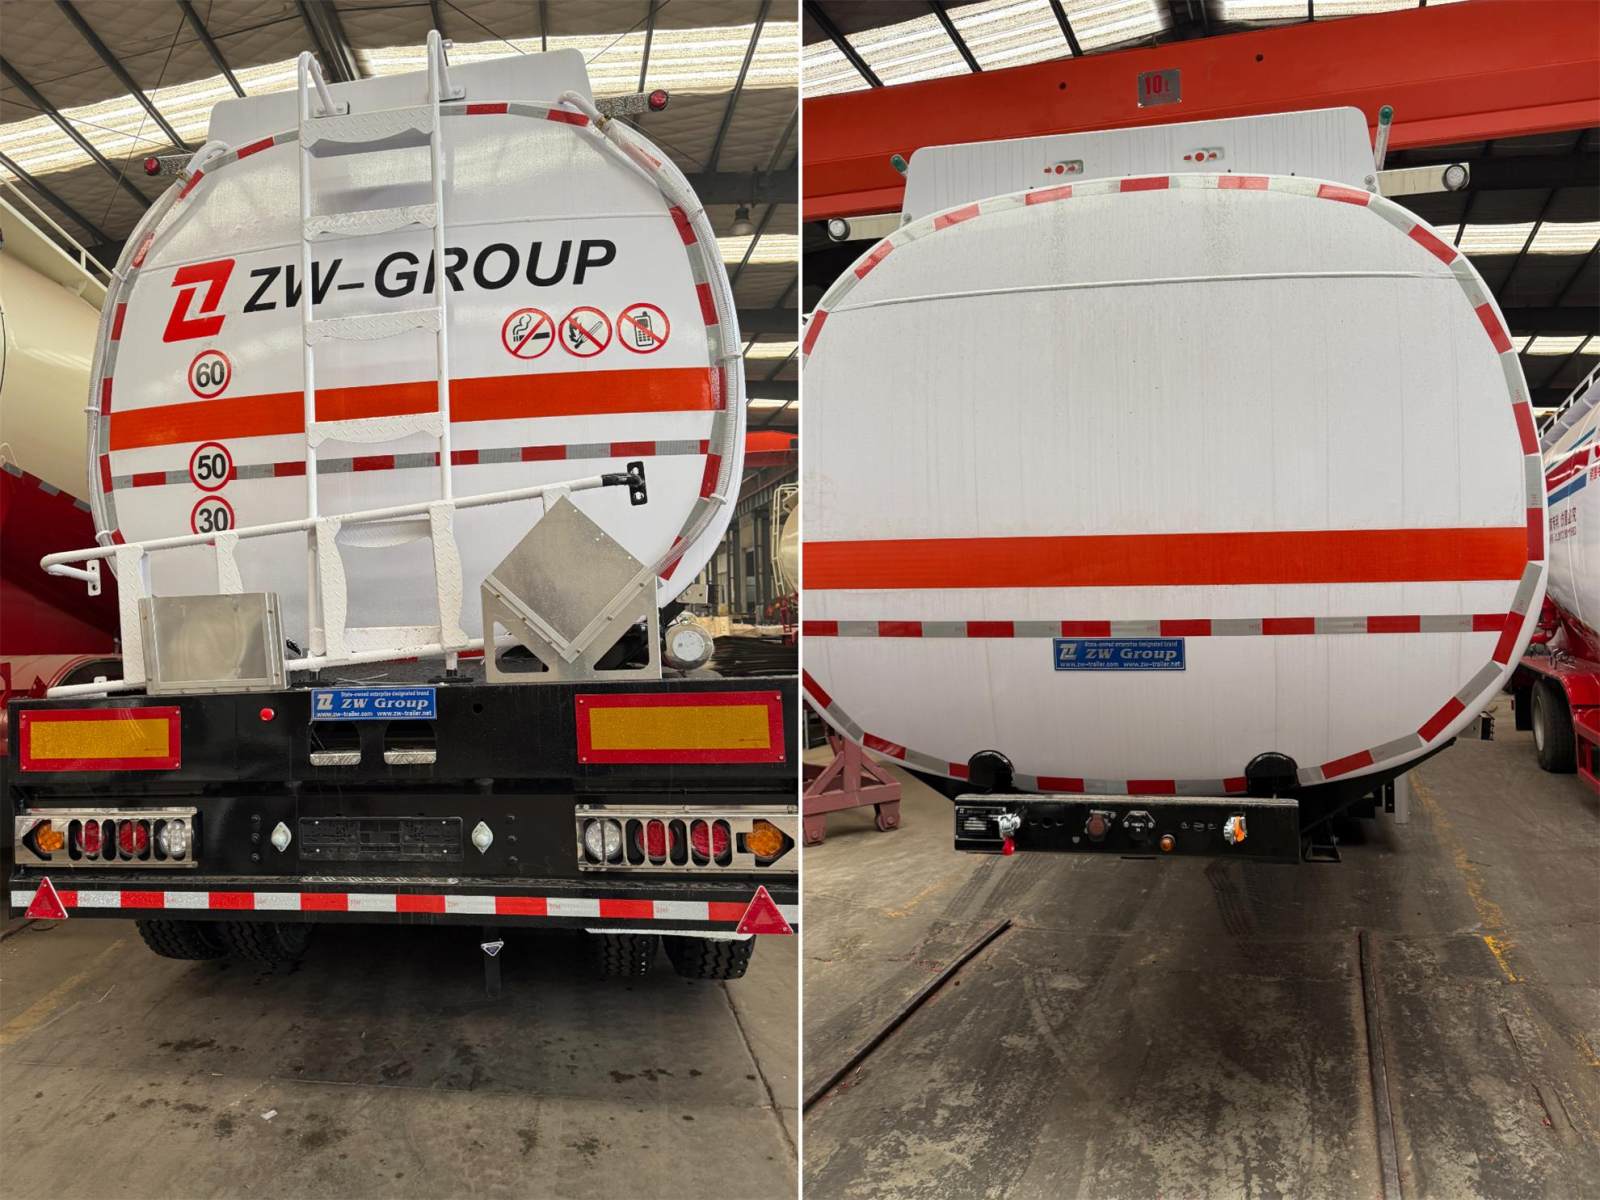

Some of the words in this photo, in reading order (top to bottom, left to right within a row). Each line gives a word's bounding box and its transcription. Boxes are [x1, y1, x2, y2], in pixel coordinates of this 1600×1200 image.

[243, 239, 617, 314] ZW-GROUP
[196, 360, 225, 388] 60
[197, 453, 227, 481] 50
[199, 507, 229, 534] 30
[1086, 648, 1113, 660] ZW
[1120, 648, 1177, 661] Group
[341, 698, 369, 709] ZW
[374, 698, 429, 710] Group
